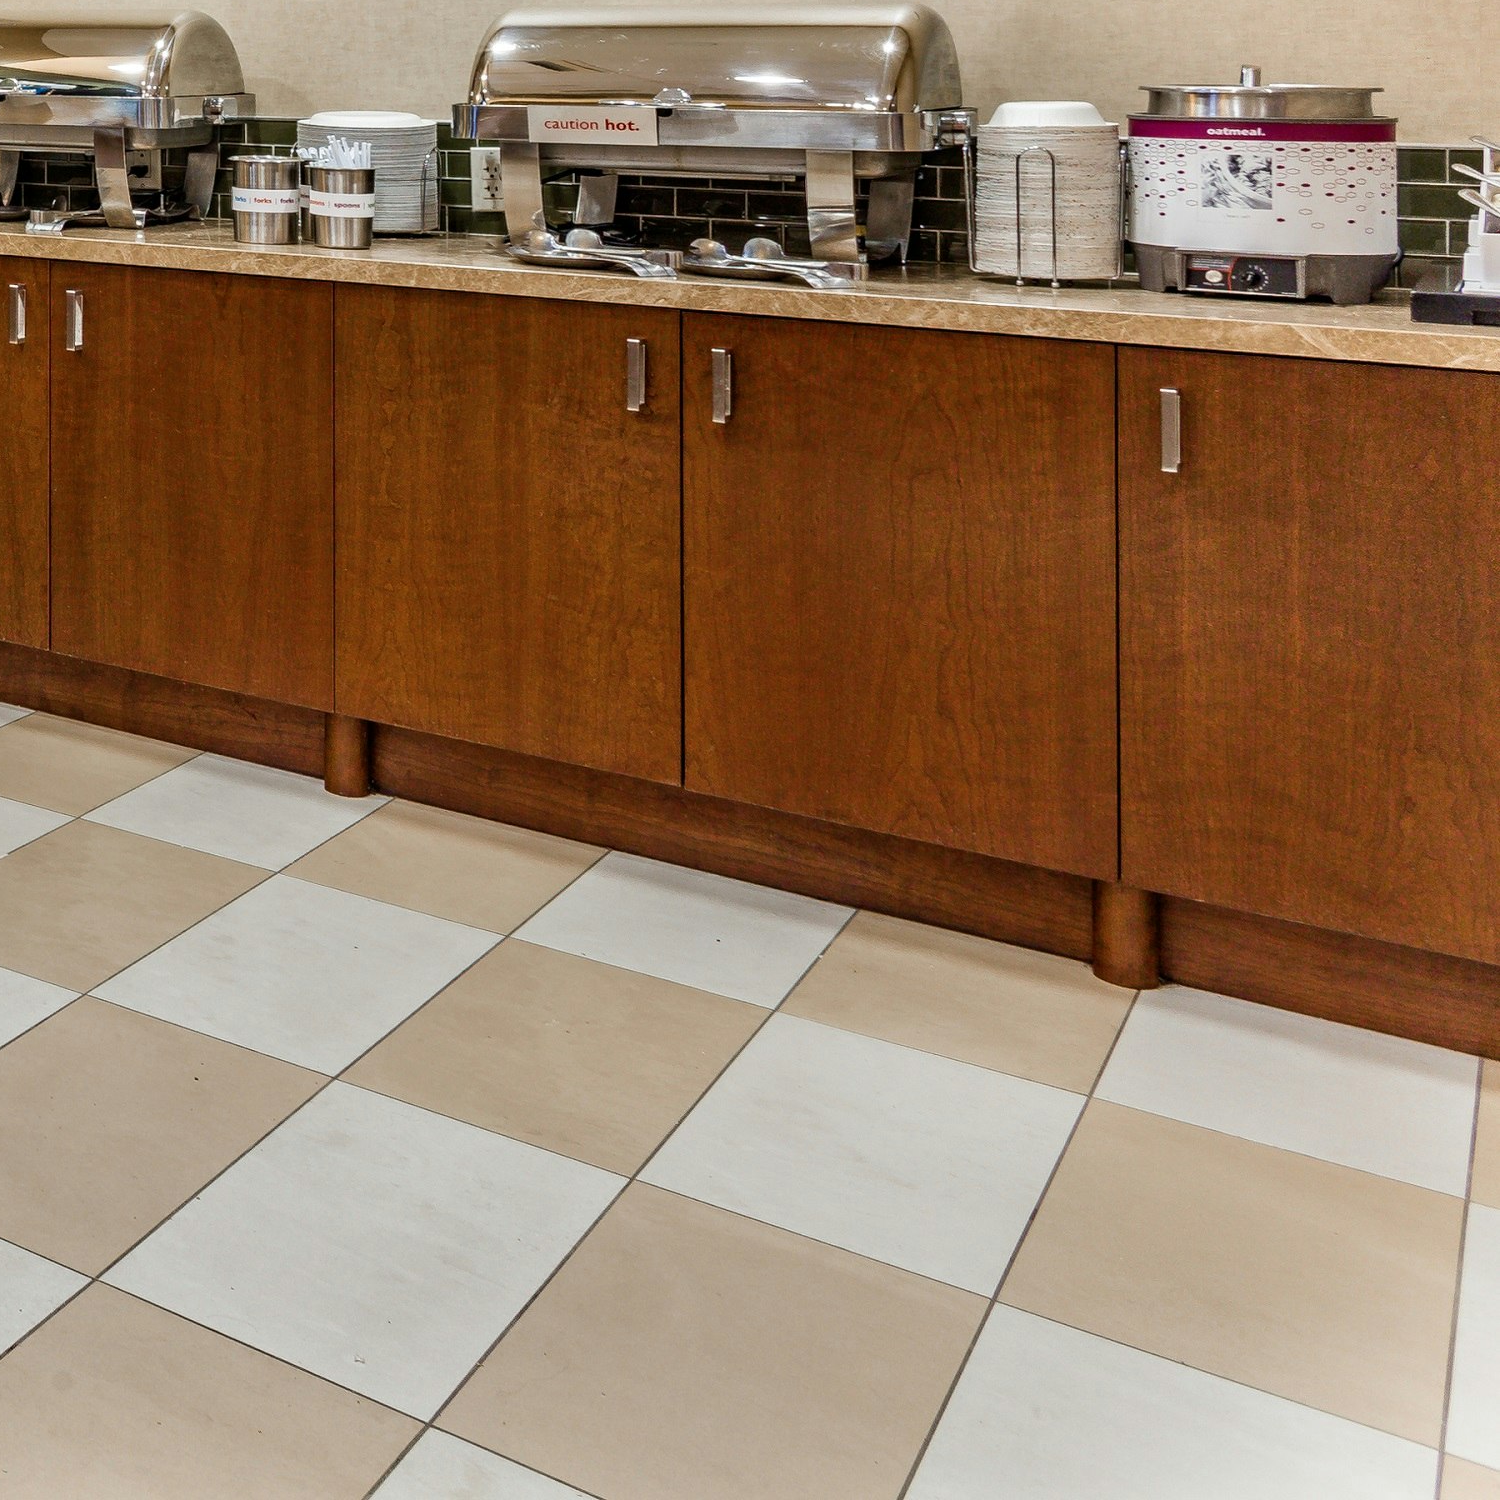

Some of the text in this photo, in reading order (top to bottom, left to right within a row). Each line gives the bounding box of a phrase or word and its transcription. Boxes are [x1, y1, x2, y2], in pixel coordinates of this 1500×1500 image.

[544, 118, 640, 132] caution hot.
[1206, 127, 1266, 137] oatmeal.
[254, 196, 272, 204] forks
